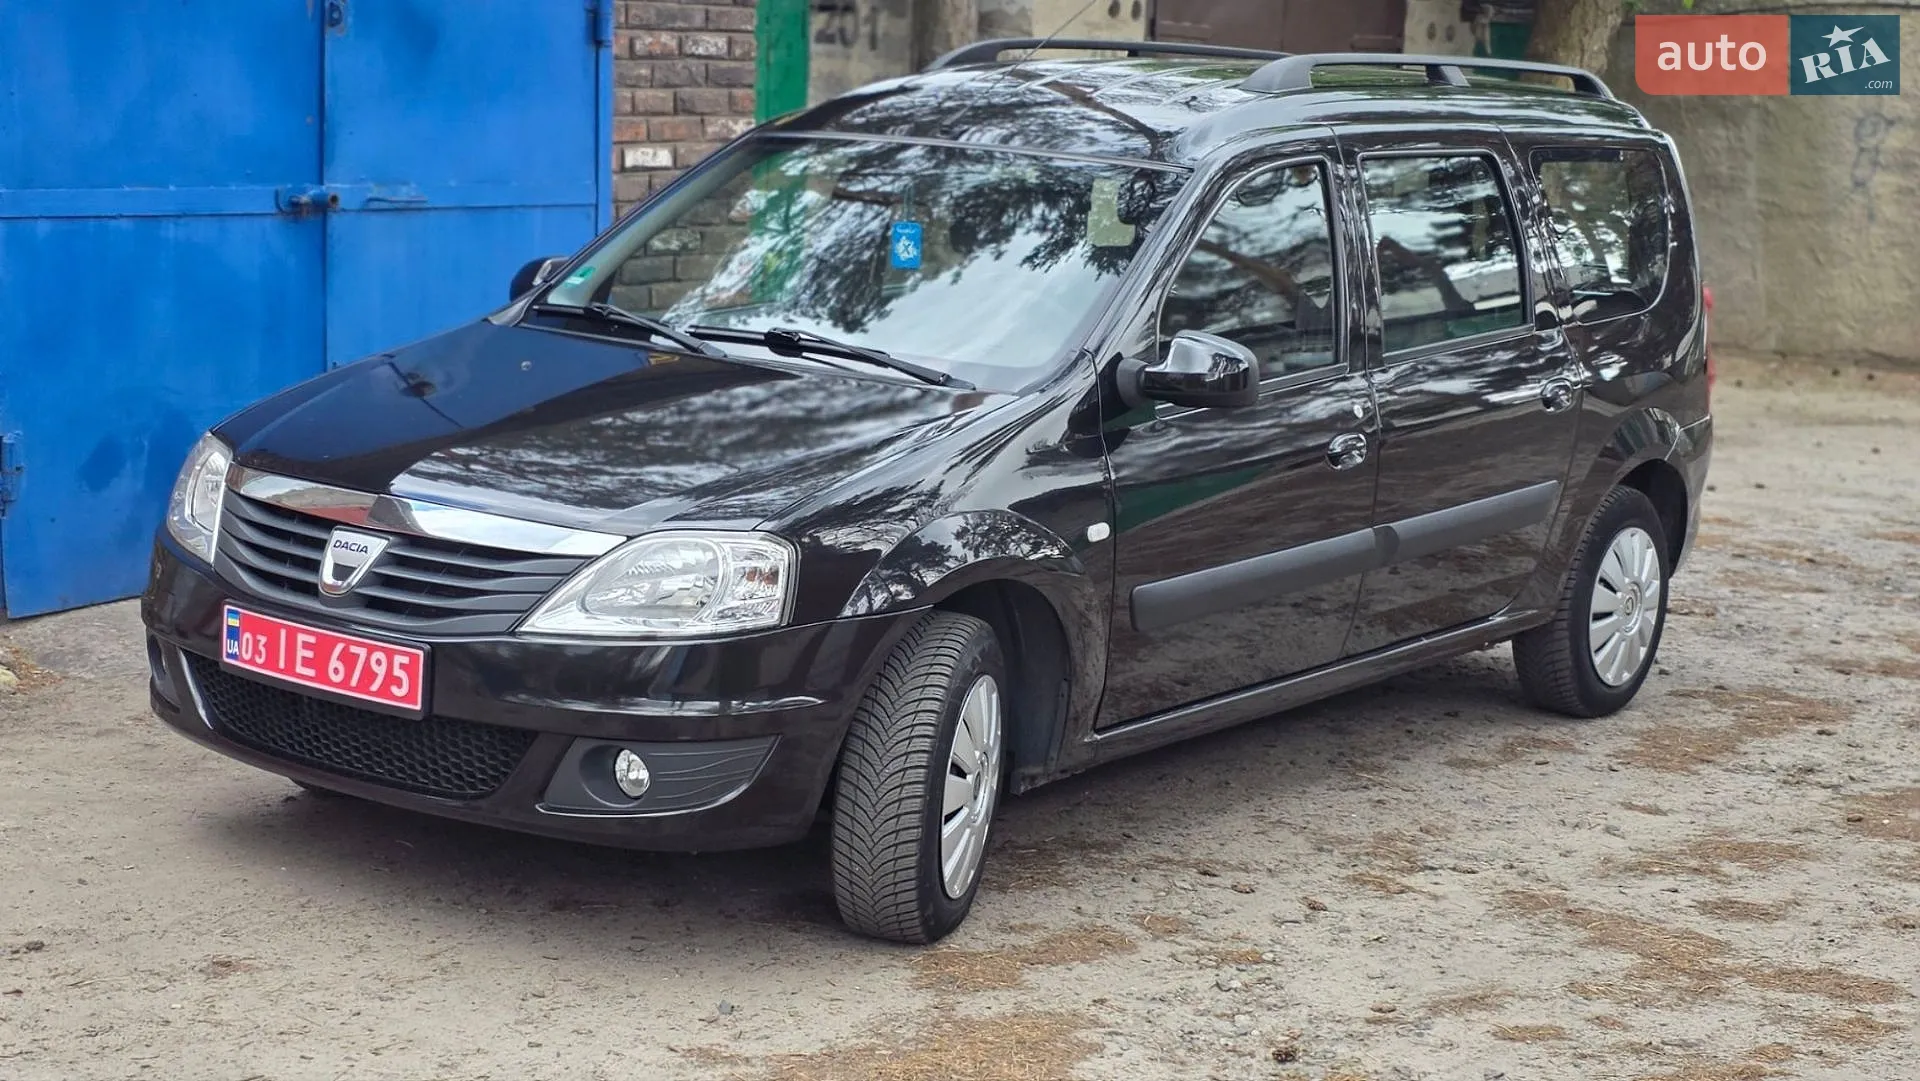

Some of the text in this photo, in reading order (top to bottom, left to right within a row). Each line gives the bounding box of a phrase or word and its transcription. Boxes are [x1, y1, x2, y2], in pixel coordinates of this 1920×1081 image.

[333, 539, 369, 554] DACIA
[226, 639, 240, 656] UA
[241, 628, 411, 697] 03 IE 6795
